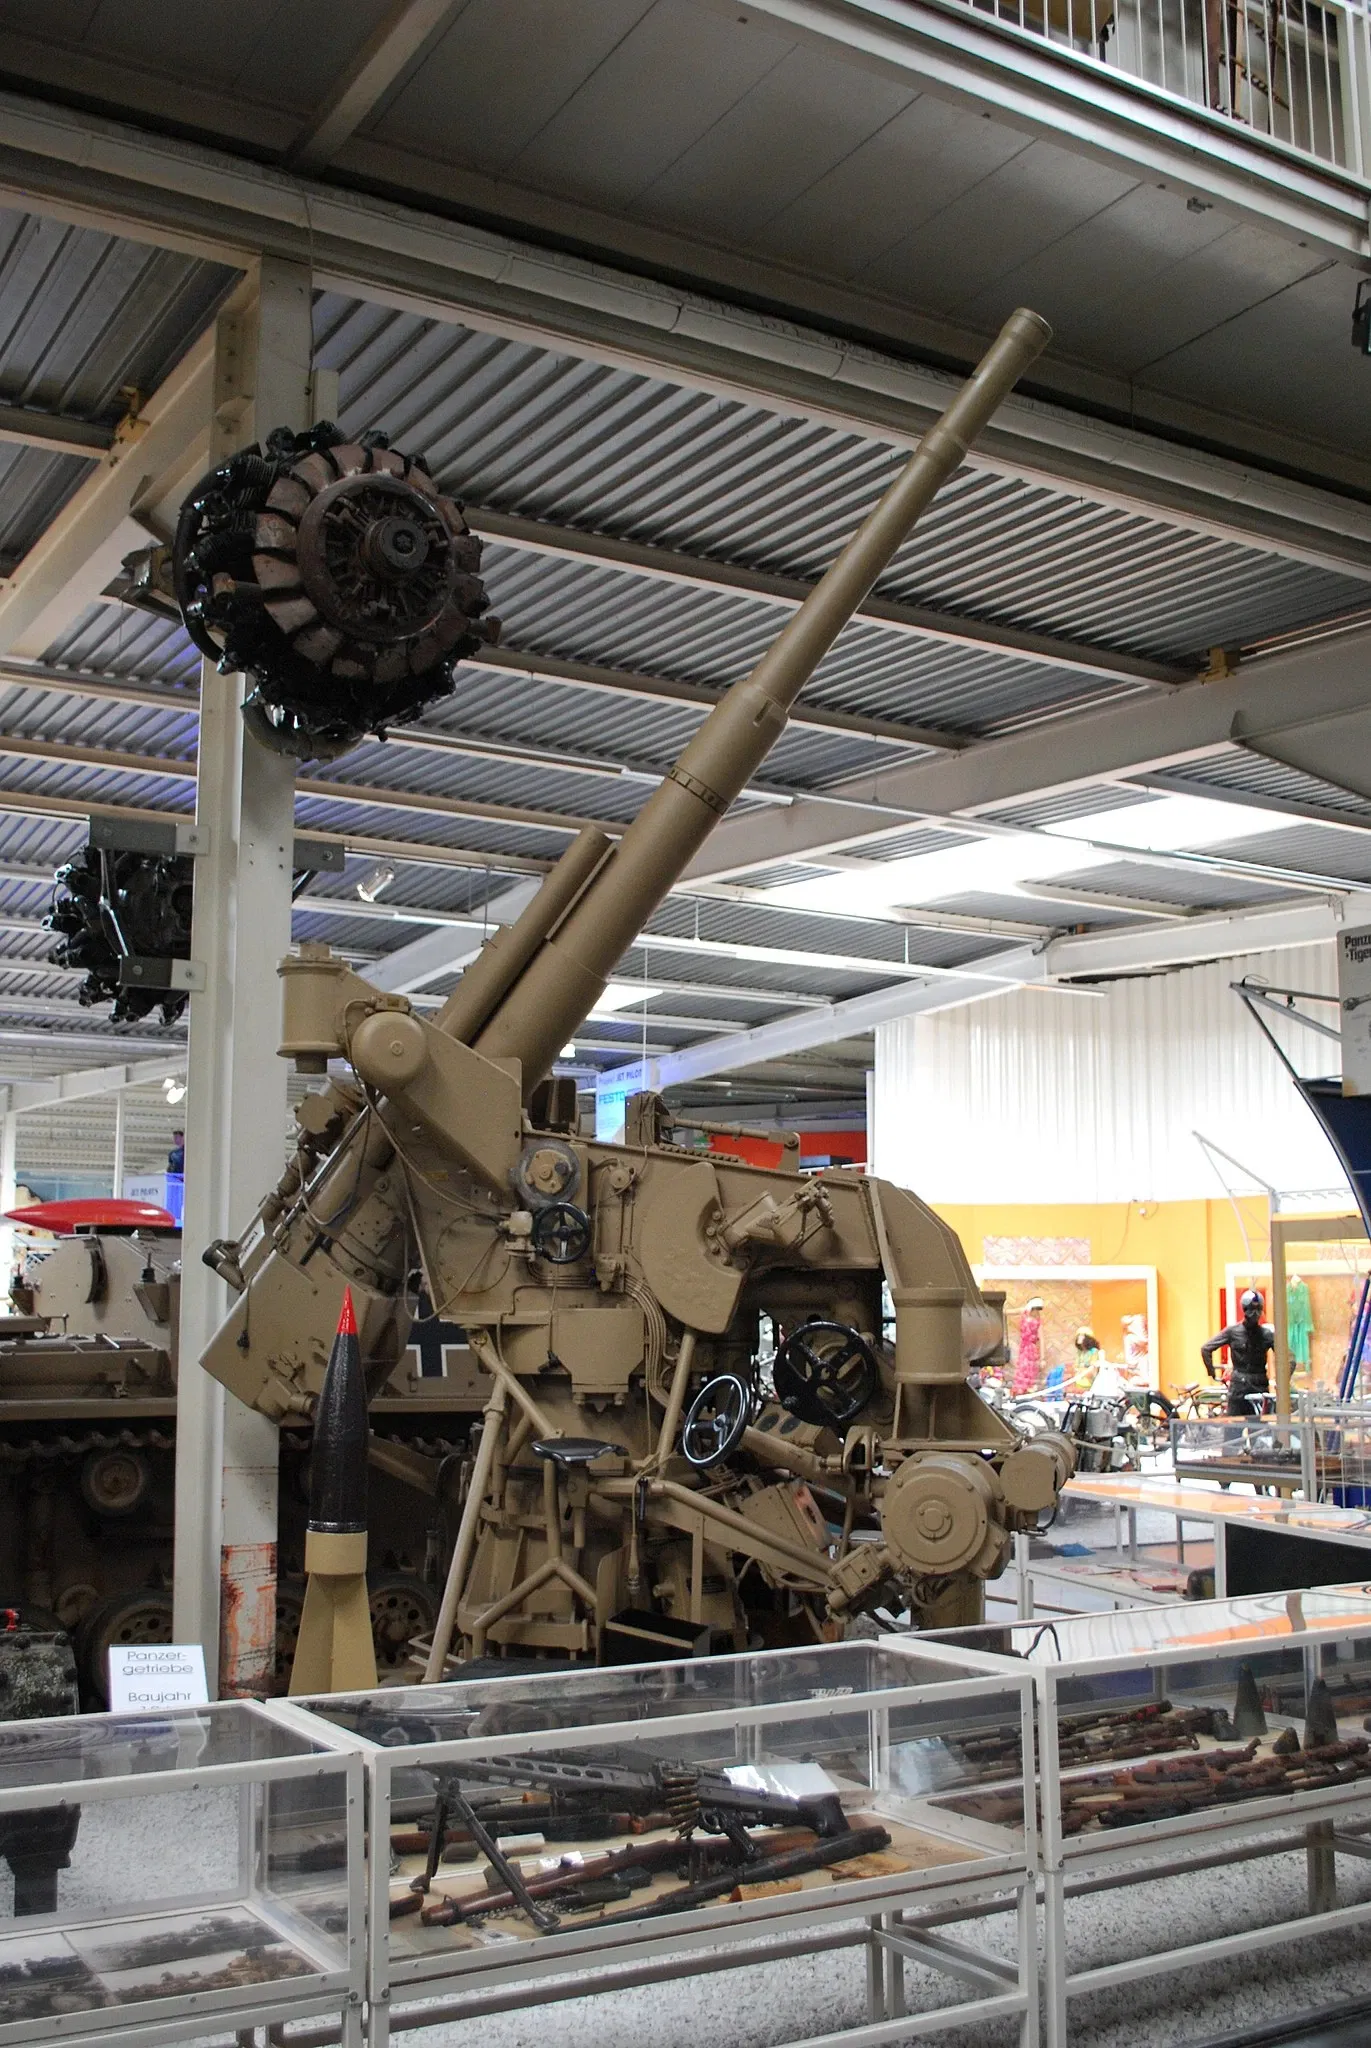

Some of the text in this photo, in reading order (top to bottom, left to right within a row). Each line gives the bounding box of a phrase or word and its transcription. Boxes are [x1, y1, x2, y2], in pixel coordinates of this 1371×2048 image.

[127, 1651, 187, 1661] Panzer-
[122, 1664, 194, 1675] getriebe
[128, 1691, 192, 1703] Baujahr
